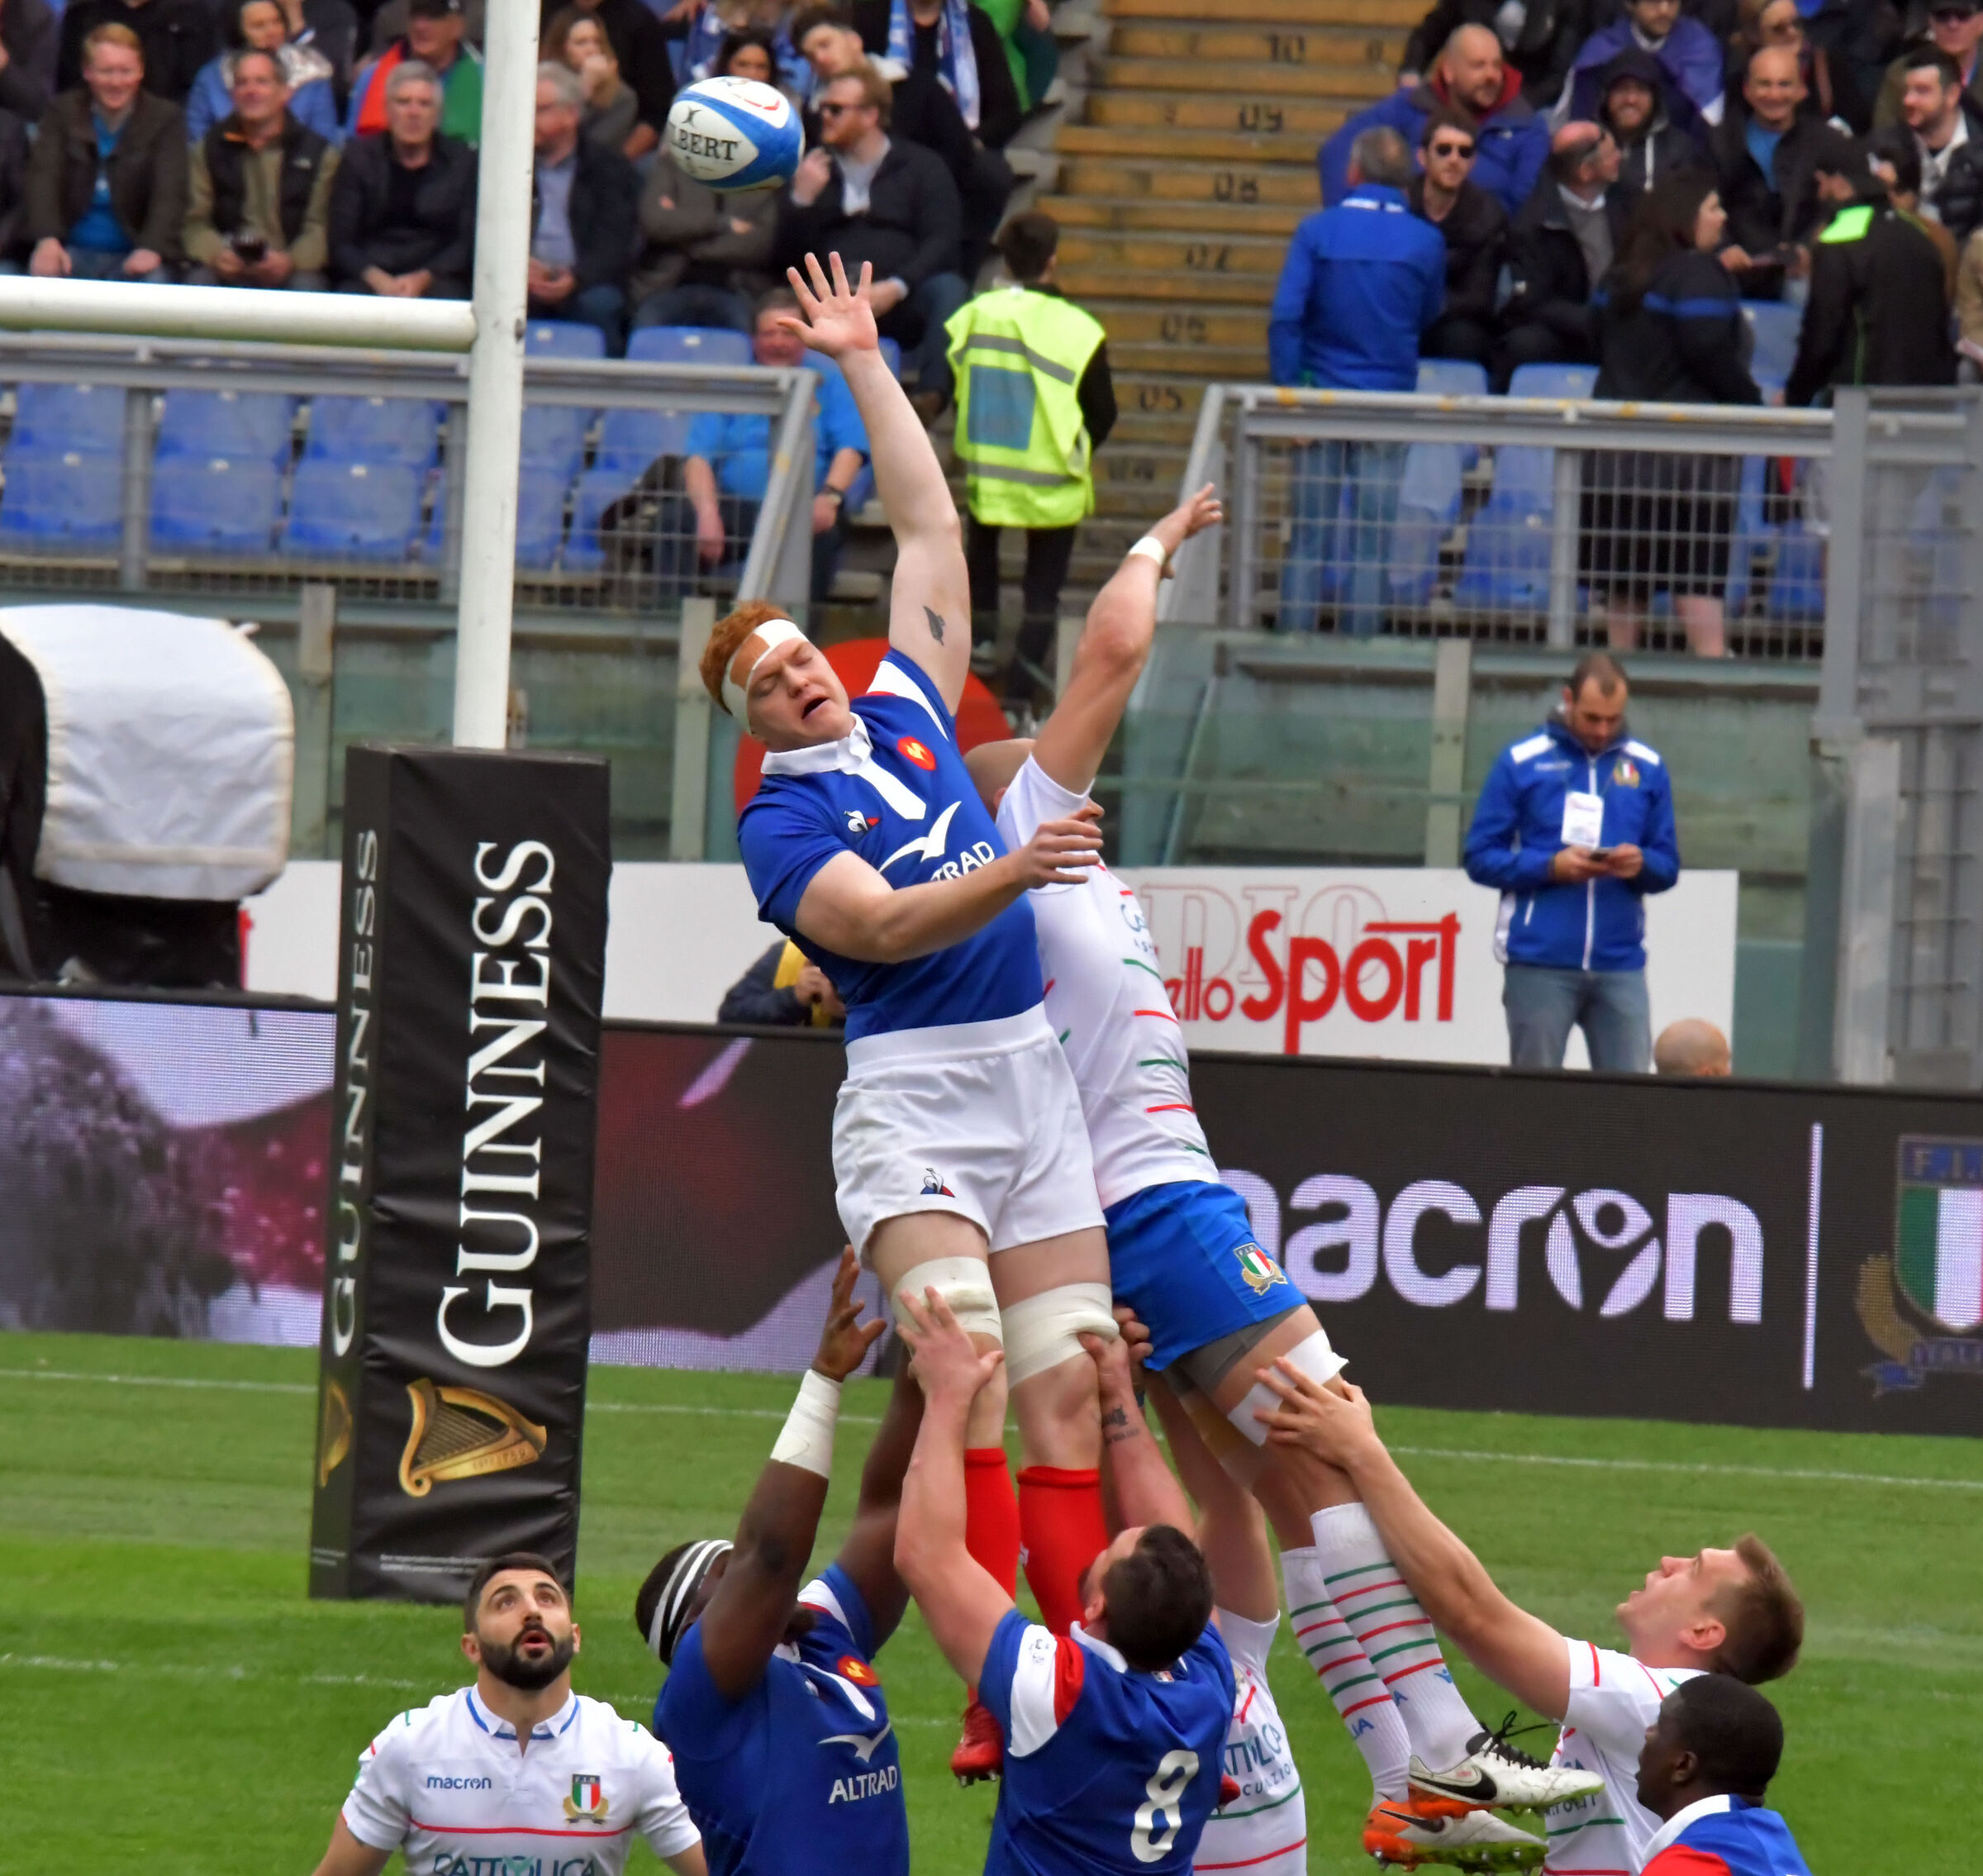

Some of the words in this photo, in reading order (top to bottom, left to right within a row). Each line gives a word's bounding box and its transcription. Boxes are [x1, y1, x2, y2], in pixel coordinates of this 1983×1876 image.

[1240, 910, 1461, 1055] Sport
[333, 829, 378, 1358] GUINNESS
[436, 840, 557, 1368] GUINNESS
[426, 1776, 492, 1789] macron
[829, 1765, 898, 1804] ALTRAD
[1129, 1750, 1200, 1864] 8
